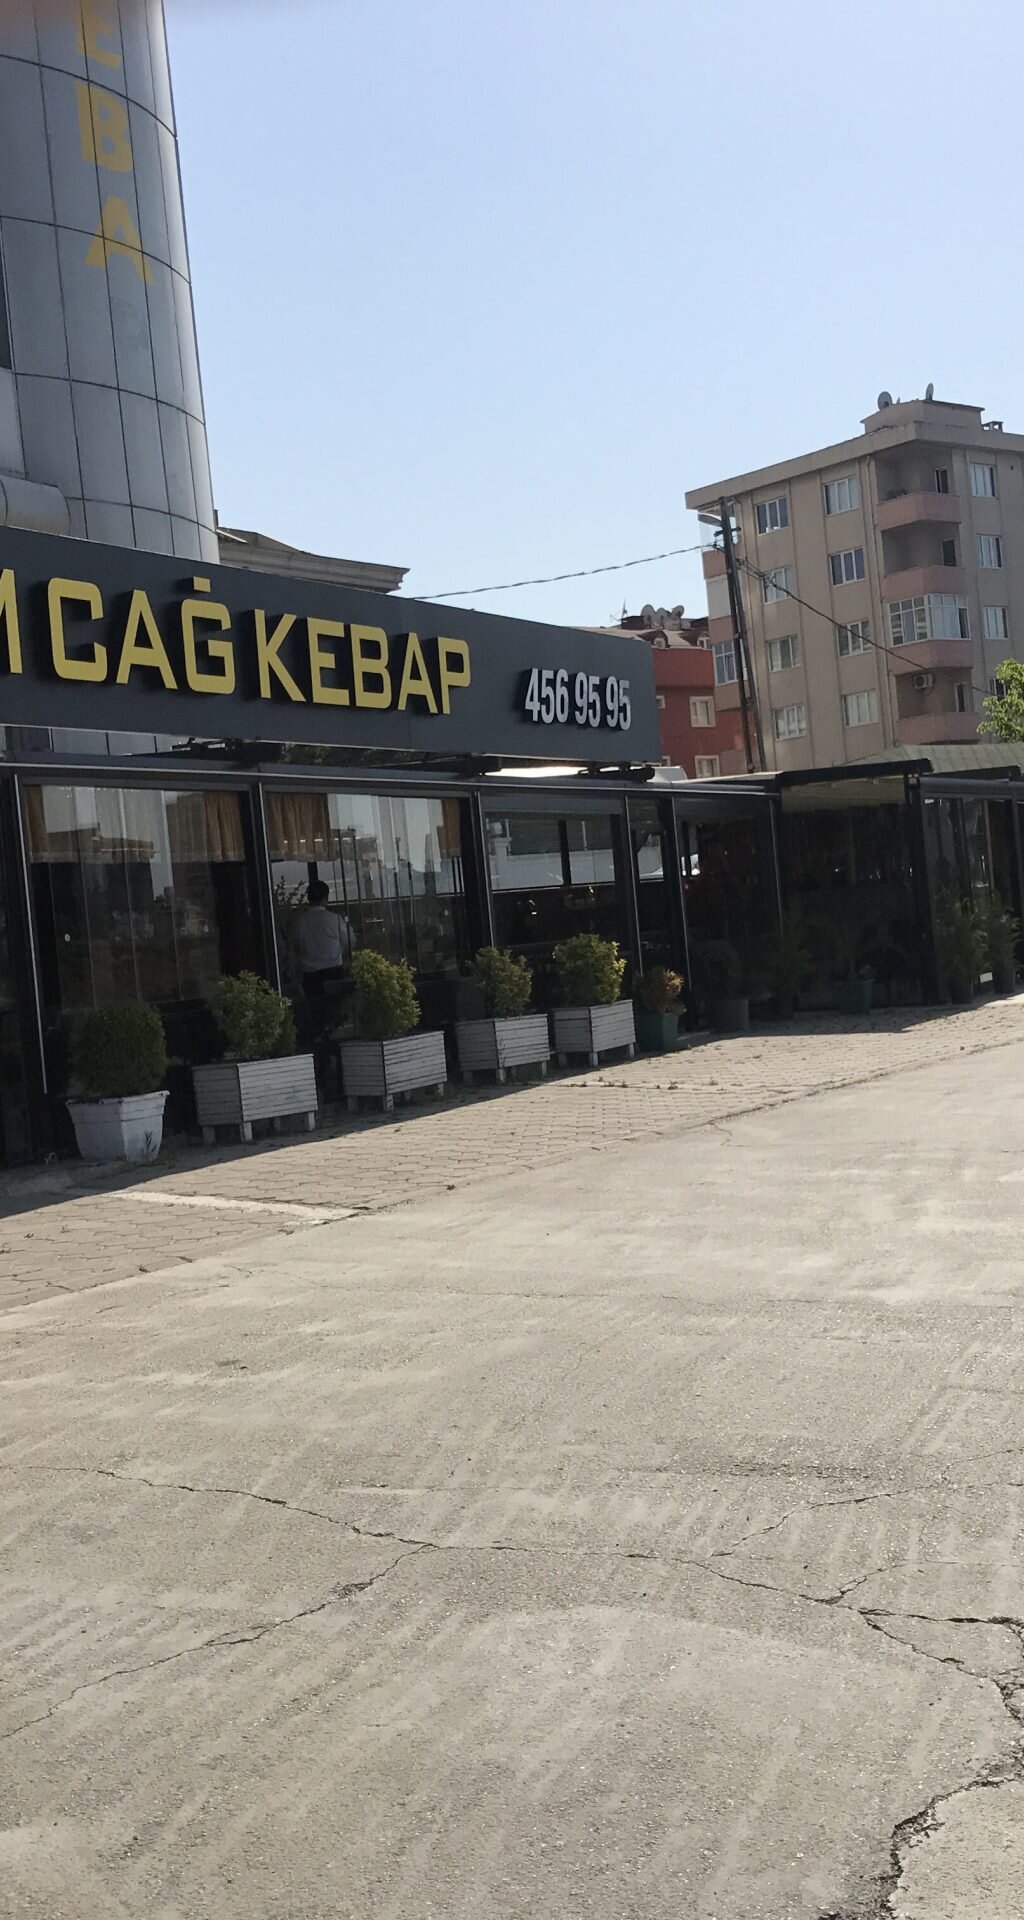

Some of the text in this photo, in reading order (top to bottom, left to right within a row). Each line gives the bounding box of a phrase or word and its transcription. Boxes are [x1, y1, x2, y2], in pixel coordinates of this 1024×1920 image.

[254, 608, 471, 715] KEBAP
[525, 668, 632, 731] 456 95 95
